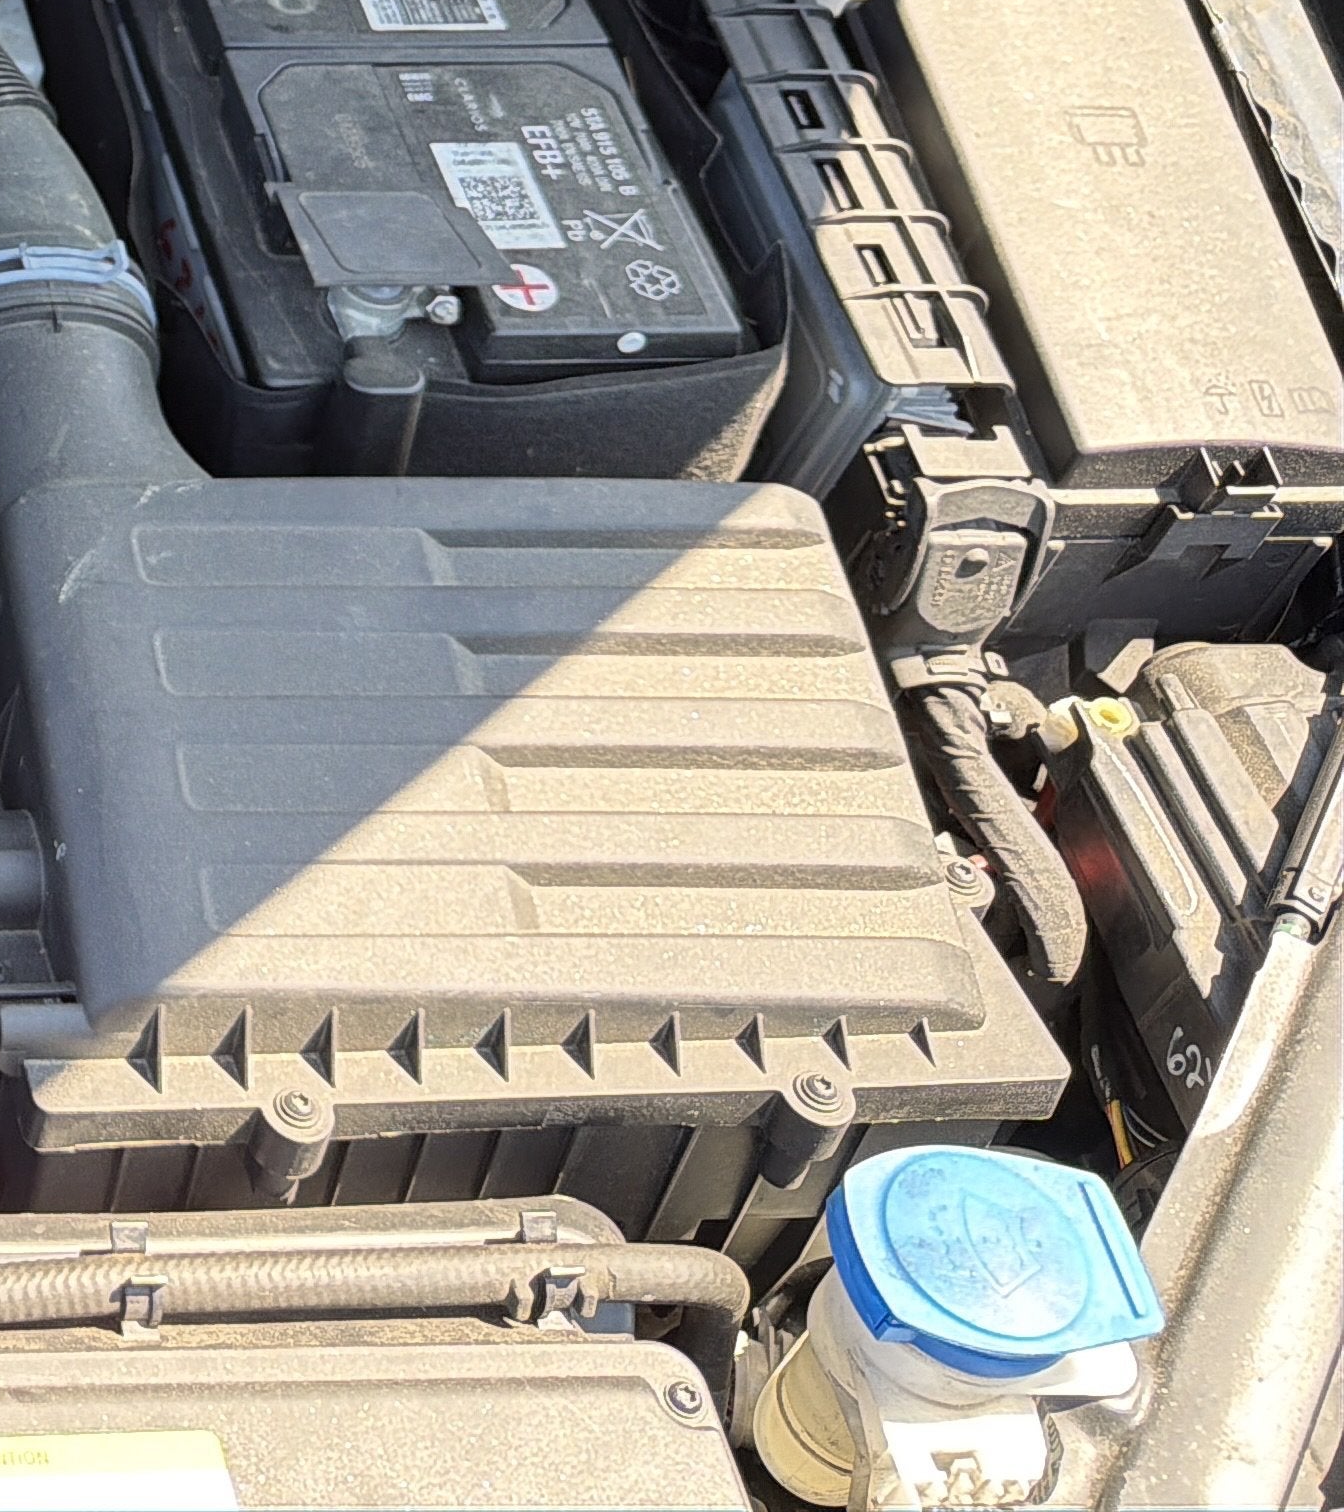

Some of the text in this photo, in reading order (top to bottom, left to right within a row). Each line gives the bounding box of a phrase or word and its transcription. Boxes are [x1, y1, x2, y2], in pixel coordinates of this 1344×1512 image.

[454, 77, 488, 132] CLARIOS
[520, 125, 566, 181] EFB+
[561, 219, 587, 242] Pb
